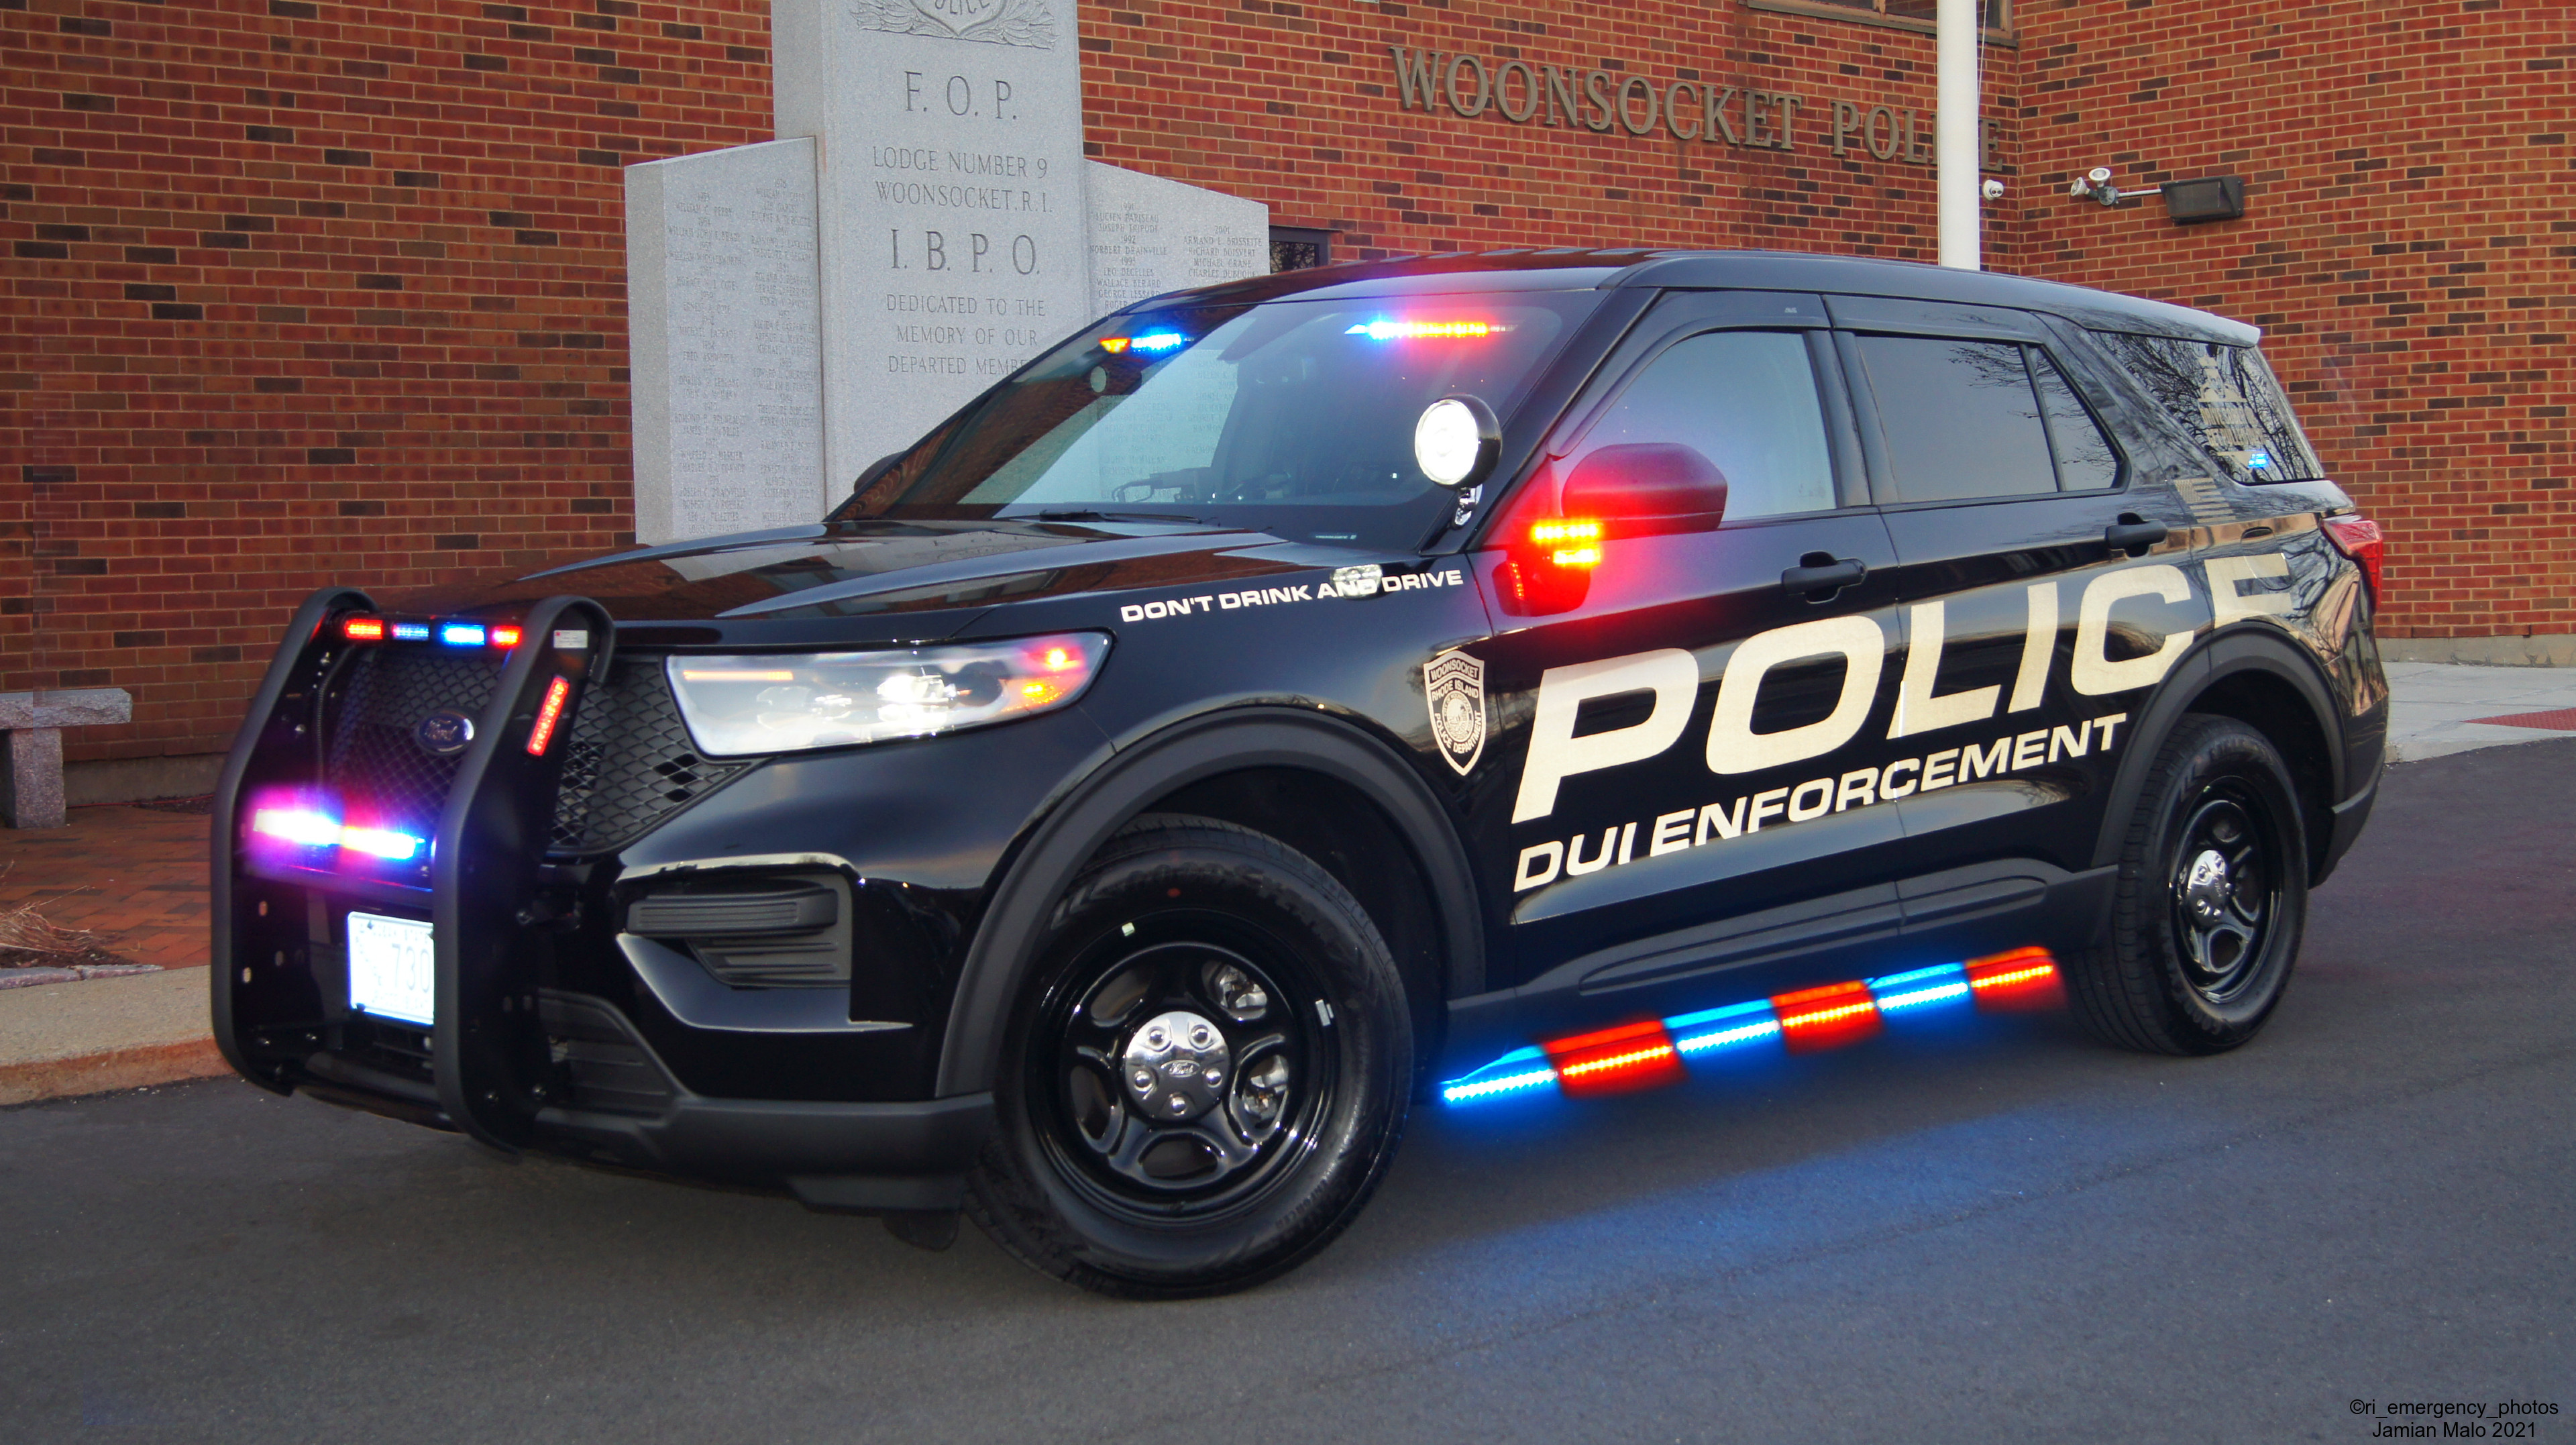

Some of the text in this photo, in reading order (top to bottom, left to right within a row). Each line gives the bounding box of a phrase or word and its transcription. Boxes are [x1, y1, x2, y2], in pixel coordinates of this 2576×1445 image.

[904, 70, 1018, 120] F. O. P.
[1389, 46, 1803, 153] WOONSOCKET
[873, 146, 1048, 178] LODGE NUMBER 9
[926, 229, 951, 272] B.
[971, 233, 993, 274] P.
[1012, 233, 1040, 276] O.
[1096, 278, 1128, 287] WALLACE
[1098, 289, 1126, 298] GEORGE
[885, 294, 1046, 317] DEDICATED TO THE
[896, 326, 1037, 347] MEMORY OF OUR
[888, 356, 967, 375] DEPARTED
[1120, 569, 1464, 623] DON'T DRINK AND DRIVE
[1430, 659, 1479, 681] WOONSOCKET
[1432, 679, 1479, 702] RHODE ISLAND
[1512, 553, 2294, 824] POLICE
[1434, 710, 1482, 753] POLICE DEPARTMENT
[1513, 712, 2129, 892] DUI ENFORCEMENT
